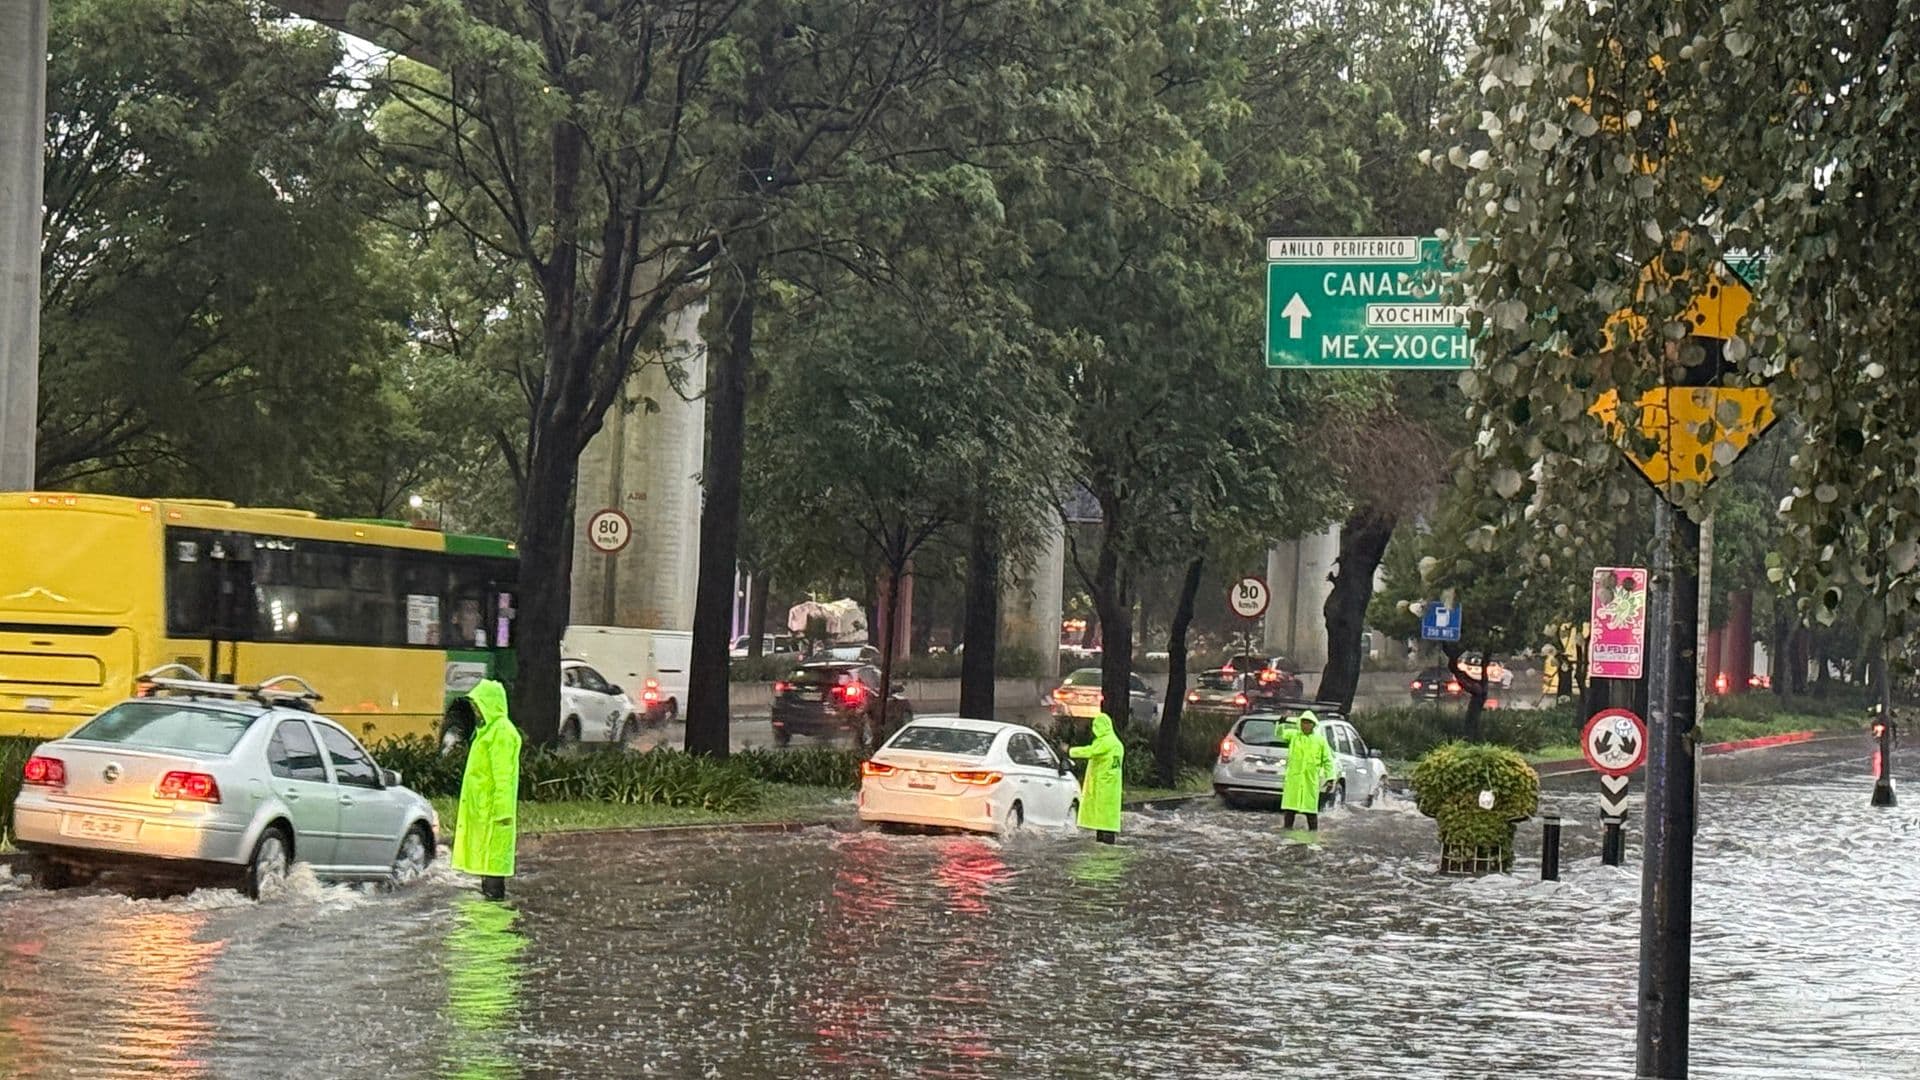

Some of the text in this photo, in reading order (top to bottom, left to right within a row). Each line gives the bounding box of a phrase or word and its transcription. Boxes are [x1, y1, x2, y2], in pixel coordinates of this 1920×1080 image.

[1280, 241, 1405, 257] ANILLO PERIFERICO
[599, 519, 619, 534] 80
[1239, 585, 1259, 599] 80
